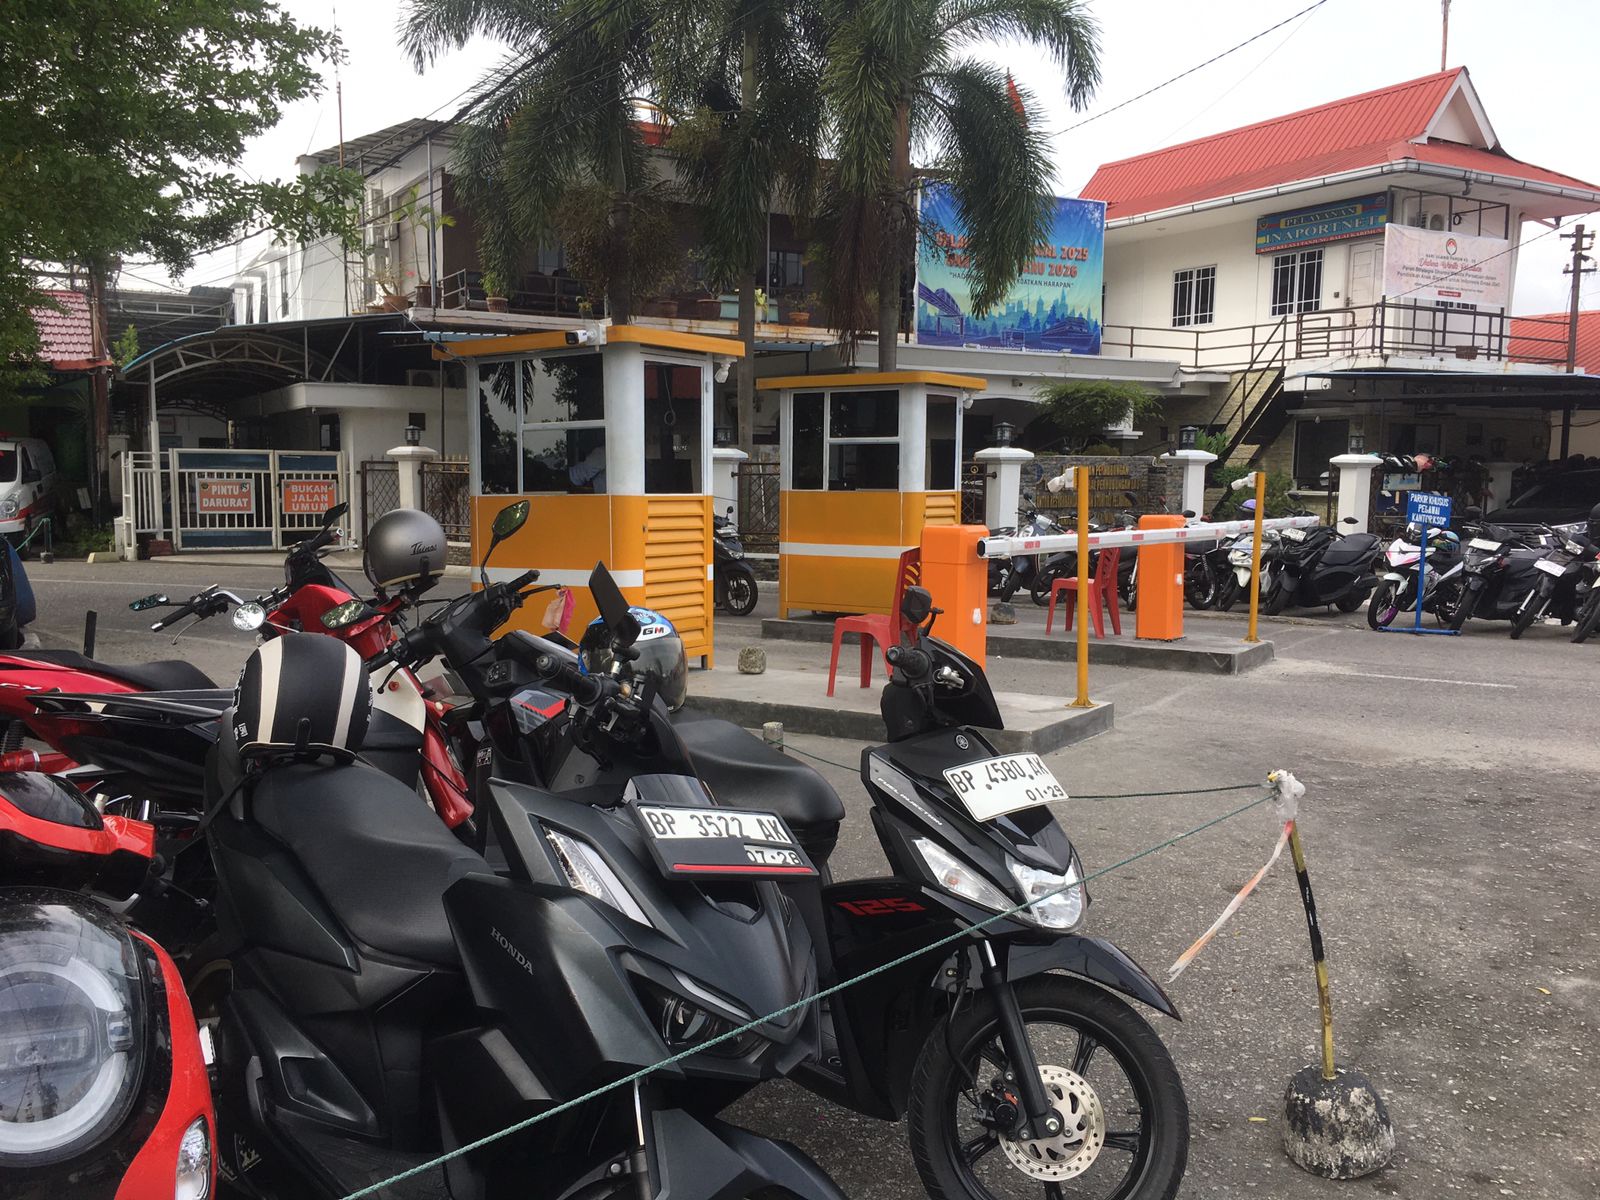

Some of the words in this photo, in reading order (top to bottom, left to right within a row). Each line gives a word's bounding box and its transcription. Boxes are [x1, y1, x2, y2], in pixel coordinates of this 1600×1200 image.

[1285, 206, 1357, 227] PELAYANAN
[1265, 216, 1376, 244] INAPORTNET
[1061, 246, 1089, 261] 2025
[1048, 263, 1078, 278] 2026
[211, 484, 239, 495] PINTU
[291, 484, 329, 493] BUKAN
[202, 498, 249, 508] DARURAT
[292, 494, 328, 502] JALAN
[1410, 493, 1429, 504] PARKIR
[1429, 496, 1450, 507] KHUSUS
[292, 502, 329, 511] UMUM
[1417, 503, 1441, 515] PEGAWAI
[1411, 512, 1433, 524] KANTOR
[642, 626, 665, 636] GM
[949, 770, 976, 793] BP
[985, 759, 1027, 784] 4580
[1026, 757, 1050, 776] AK
[646, 811, 677, 836] BP
[756, 818, 789, 842] AK
[836, 898, 928, 917] 125
[490, 926, 534, 976] HONDA
